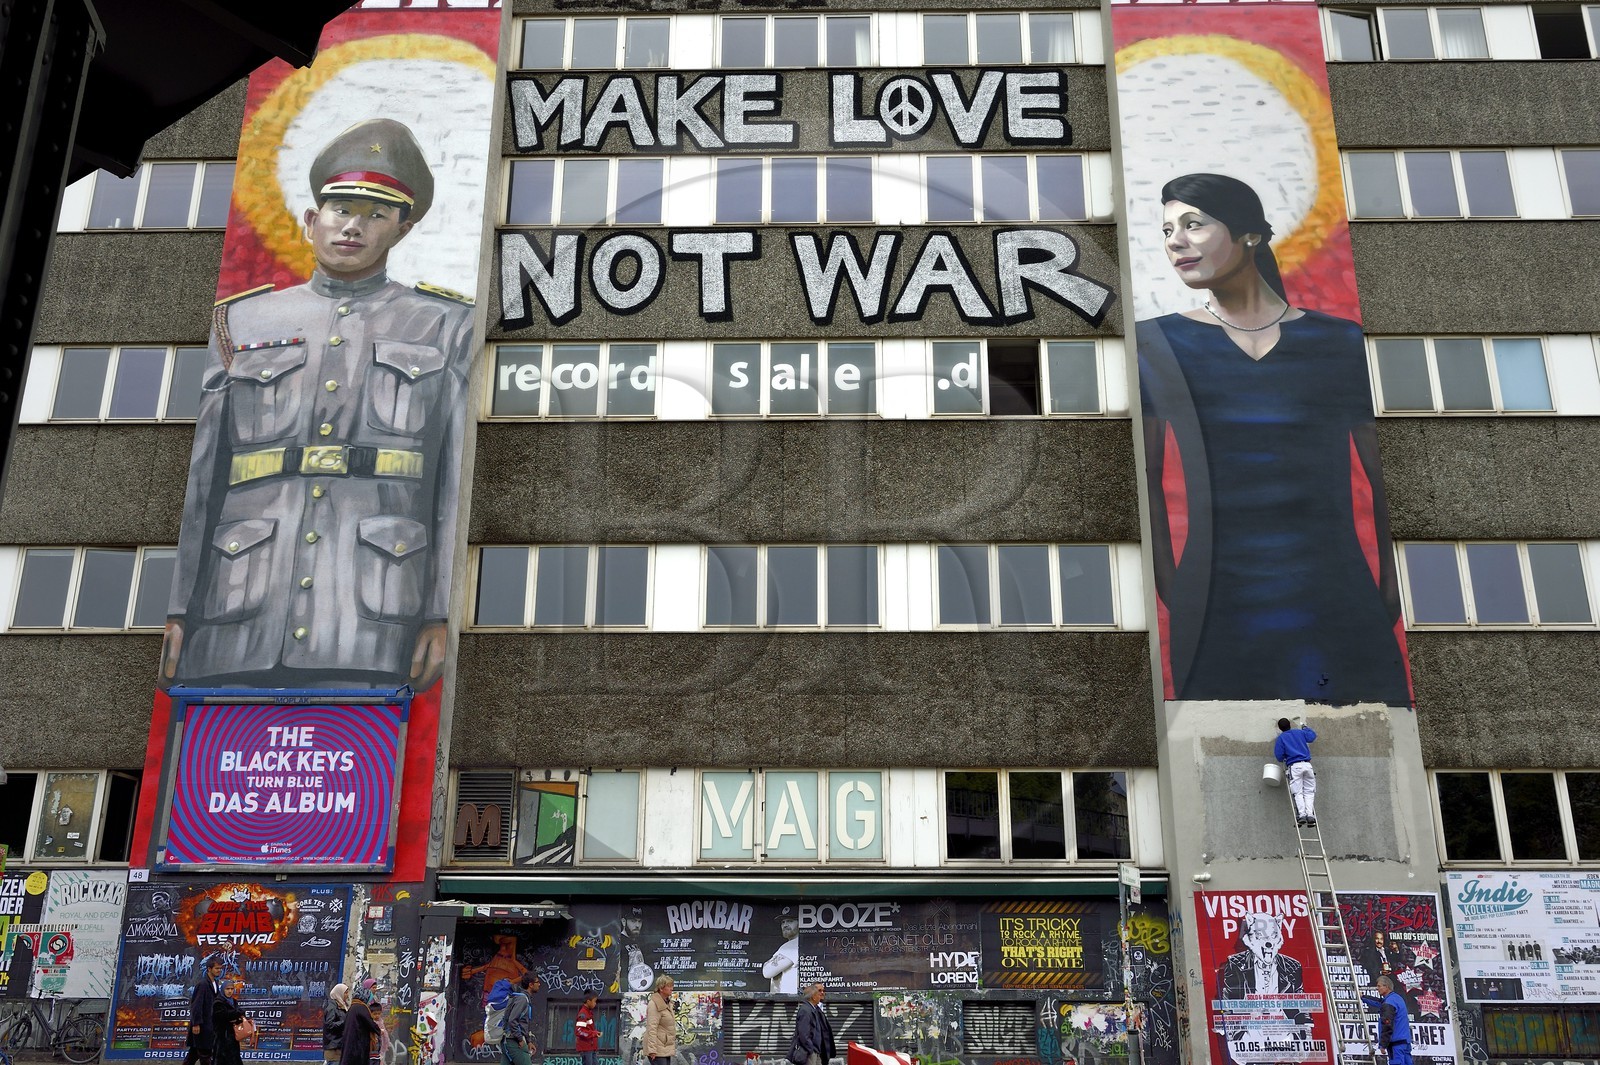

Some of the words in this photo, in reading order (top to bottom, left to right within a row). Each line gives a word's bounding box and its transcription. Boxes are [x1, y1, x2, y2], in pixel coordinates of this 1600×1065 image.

[508, 71, 800, 150] MAKE
[830, 69, 1072, 149] LOVE
[498, 230, 764, 330] NOT
[791, 229, 1116, 326] WAR
[268, 727, 315, 747] THE
[220, 752, 292, 772] BLACK
[296, 752, 354, 772] KEYS
[247, 777, 283, 788] TURN
[287, 777, 323, 788] BLUE
[209, 792, 259, 813] DAS
[264, 792, 355, 813] ALBUM
[453, 803, 502, 847] M
[60, 880, 125, 906] ROCKBAR
[1458, 880, 1533, 904] Indie
[246, 901, 269, 910] THE
[1202, 894, 1308, 918] VISIONS
[1464, 904, 1505, 916] KOLLEKTIV
[199, 912, 270, 934] BOMB
[667, 901, 754, 934] ROCKBAR
[1000, 918, 1024, 930] IT'S
[1027, 918, 1081, 930] TRICKY
[197, 934, 276, 946] FESTIVAL
[870, 935, 919, 946] MAGNET
[923, 934, 954, 946] CLUB
[1014, 930, 1036, 939] ROCK
[1040, 931, 1046, 939] A
[1417, 933, 1438, 941] EDITION
[1016, 938, 1044, 946] ROCK
[1052, 938, 1082, 946] RHYME
[1002, 946, 1045, 958] THAT'S
[1047, 946, 1083, 958] RIGHT
[1002, 958, 1029, 968] ON
[1033, 958, 1084, 968] TIME
[931, 972, 978, 984] LORENZ
[1234, 1042, 1262, 1052] 10.05.
[1304, 1041, 1326, 1051] CLUB
